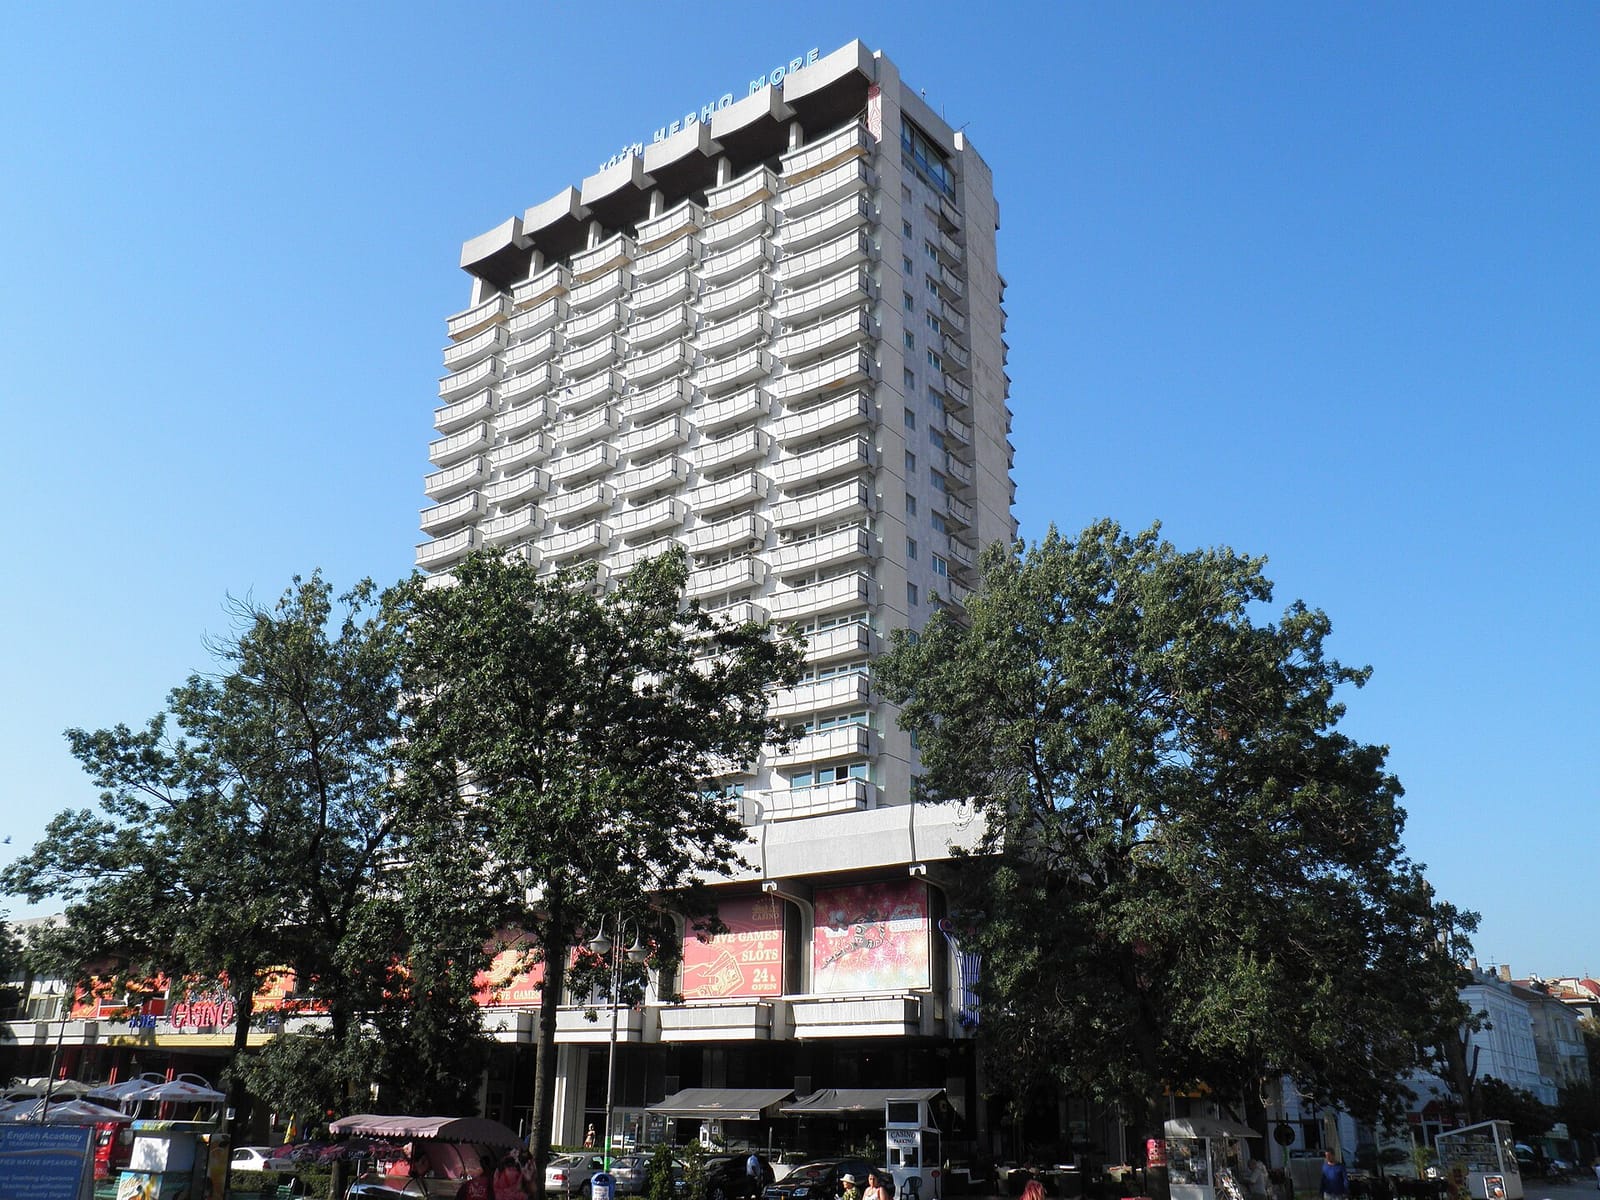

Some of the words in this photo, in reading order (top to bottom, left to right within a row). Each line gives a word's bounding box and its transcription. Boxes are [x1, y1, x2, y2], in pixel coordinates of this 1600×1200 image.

[653, 93, 734, 144] ЧЕРНО
[750, 47, 820, 96] МОРЕ
[738, 929, 779, 942] GAMES
[742, 949, 778, 961] SLOTS
[752, 968, 769, 983] 24
[751, 983, 777, 991] OPEN
[171, 1001, 235, 1029] CASINO
[7, 1131, 41, 1141] English
[42, 1132, 82, 1142] Academy
